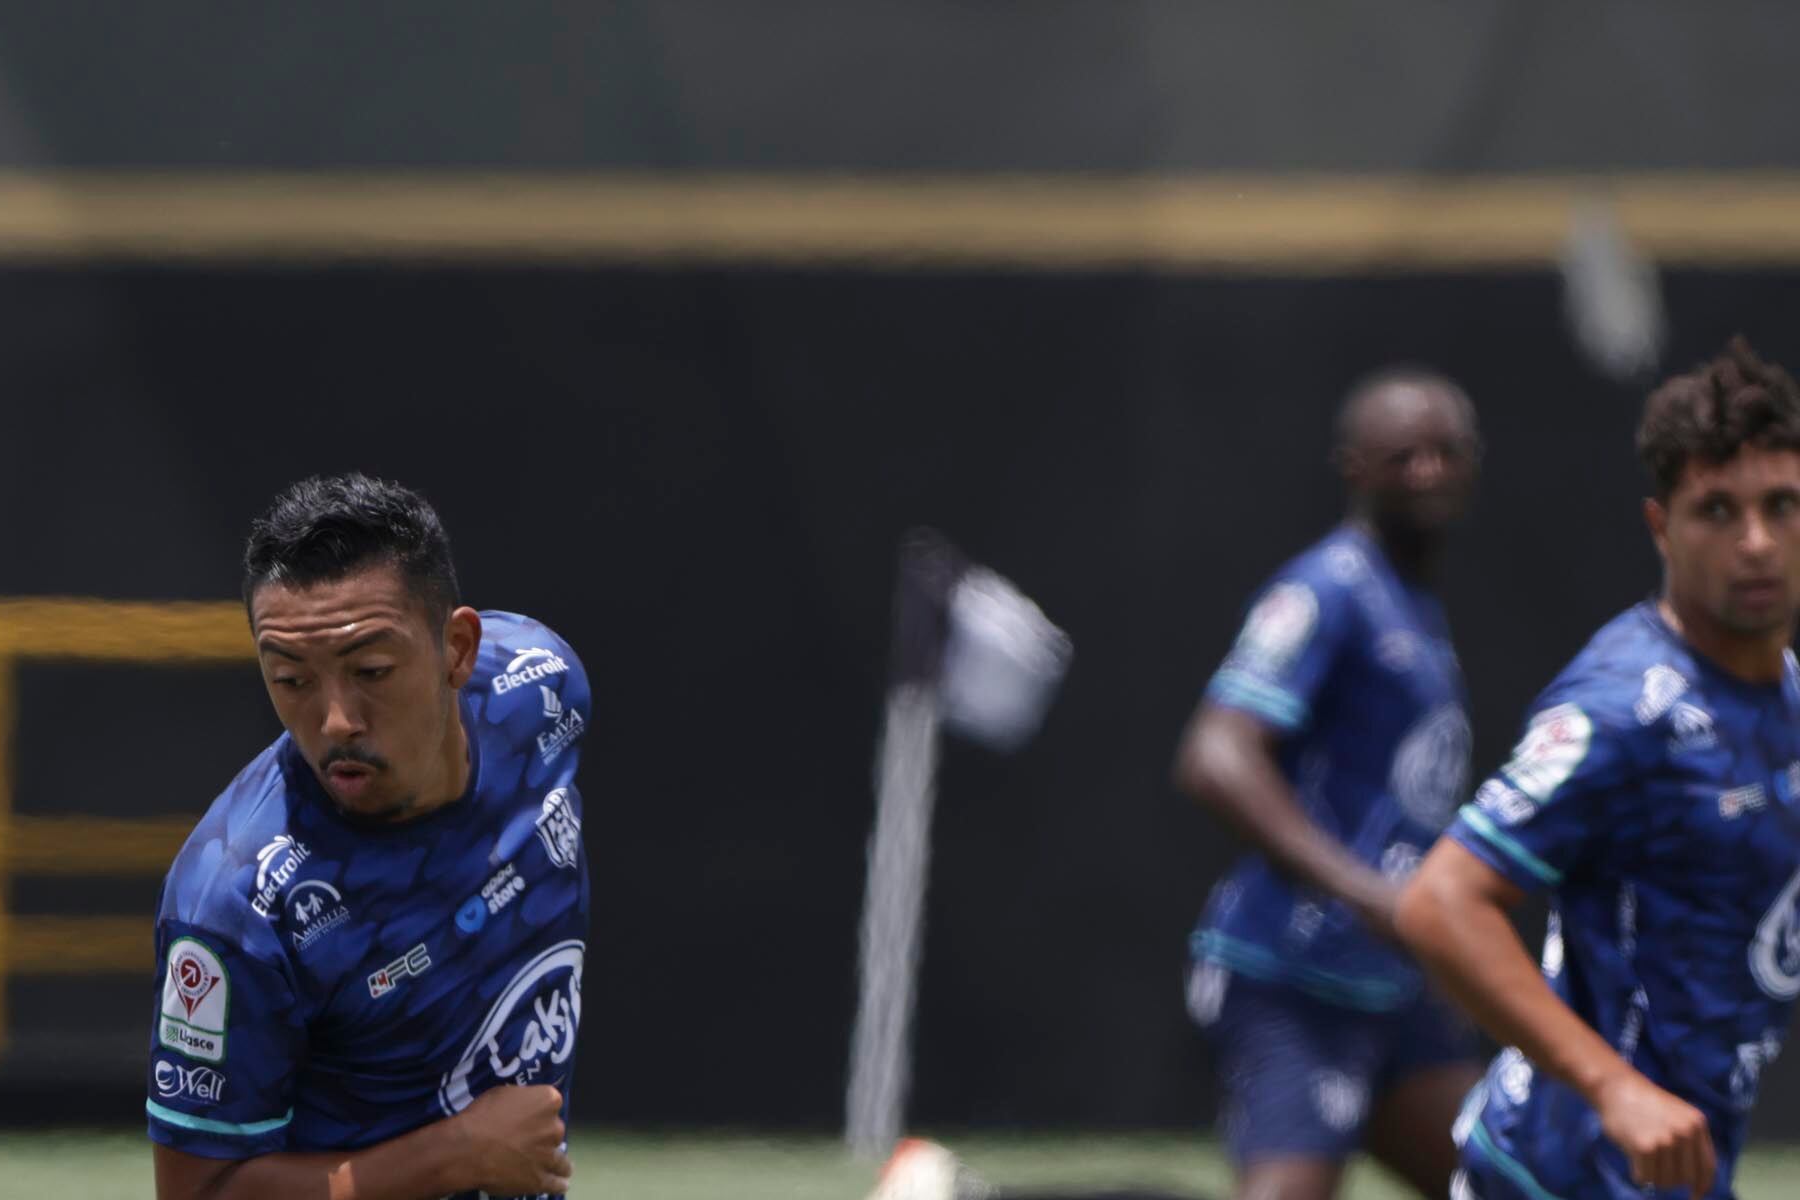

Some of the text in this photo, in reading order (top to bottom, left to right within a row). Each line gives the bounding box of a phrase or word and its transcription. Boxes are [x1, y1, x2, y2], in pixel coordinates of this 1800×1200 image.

[491, 655, 569, 696] Electrolit
[251, 842, 312, 918] Electrolit
[488, 875, 526, 915] store
